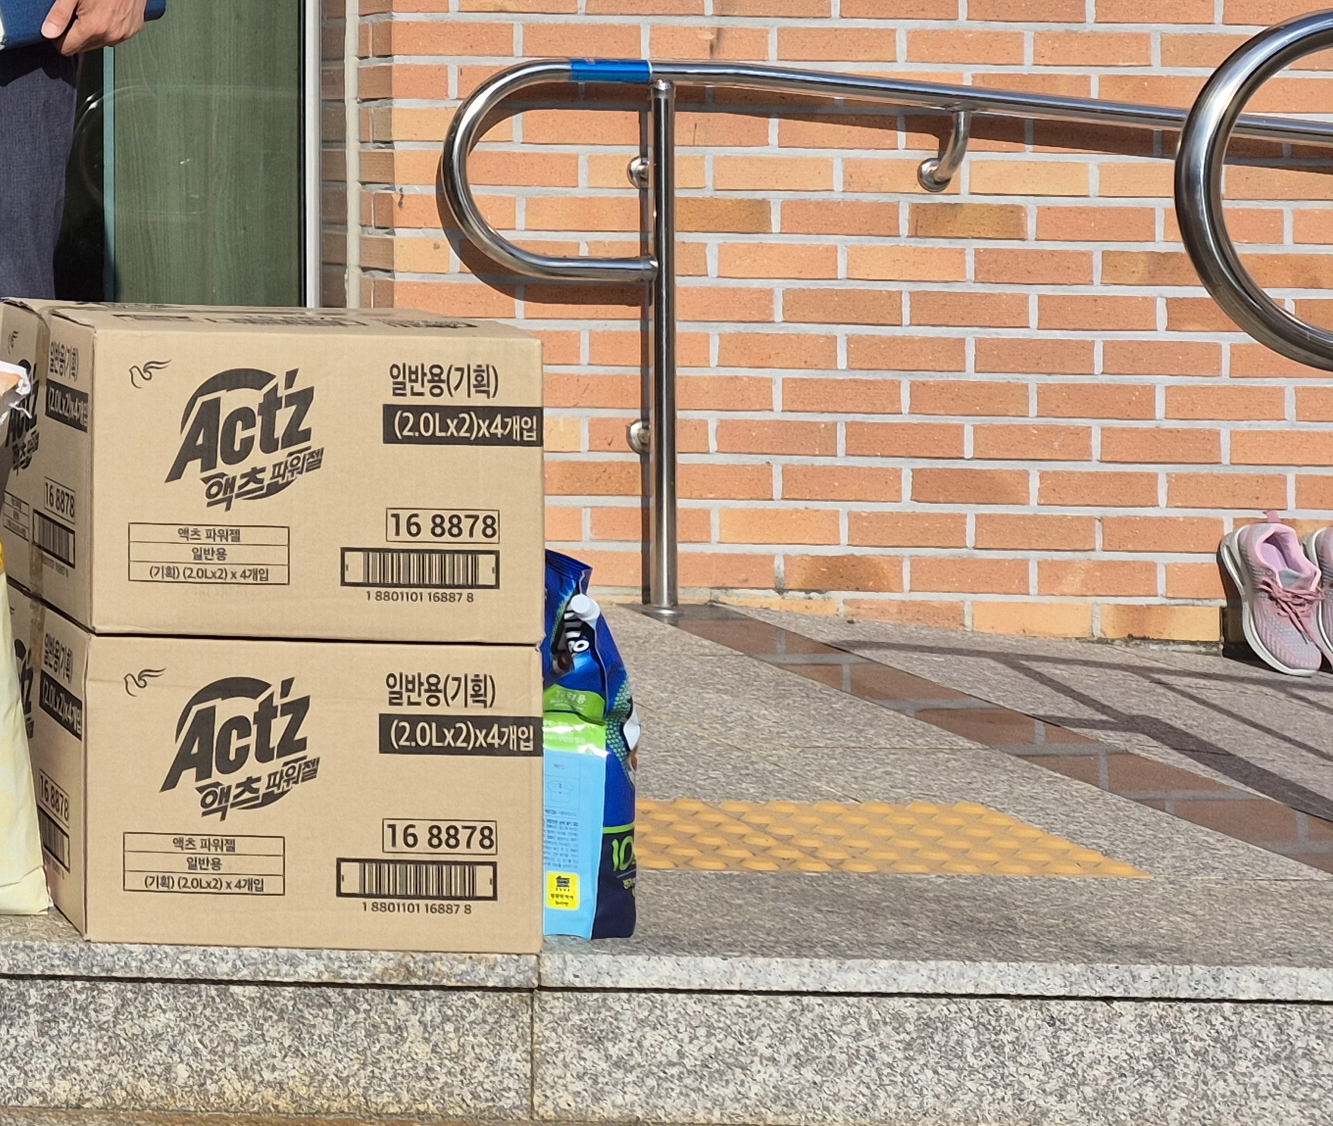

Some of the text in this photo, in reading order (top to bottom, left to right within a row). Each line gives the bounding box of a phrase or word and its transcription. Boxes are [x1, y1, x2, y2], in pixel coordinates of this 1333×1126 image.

[389, 364, 500, 400] 일반용(기획)
[393, 410, 538, 442] (2.0Lx2)x4개입
[205, 448, 324, 511] 액츠 파워젤
[44, 481, 54, 508] 16
[55, 487, 75, 519] 8878
[177, 527, 241, 542] 액츠 파워젤
[391, 512, 498, 540] 16 8878
[191, 546, 227, 561] 일반용
[149, 564, 180, 581] (기획)
[239, 567, 270, 583] 4개입
[374, 590, 425, 604] 8801101
[467, 591, 474, 604] 8
[386, 673, 497, 709] 일반용(기획)
[390, 721, 535, 753] (2.0Lx2)x4개입
[50, 783, 70, 823] 8878
[200, 757, 321, 822] 액츠 파워젤
[172, 837, 236, 852] 액츠 파워젤
[386, 823, 495, 850] 16 8878
[186, 856, 222, 871] 일반용
[144, 876, 175, 892] (기획)
[234, 877, 265, 893] 4개입
[370, 901, 421, 915] 8801101
[464, 901, 472, 915] 8
